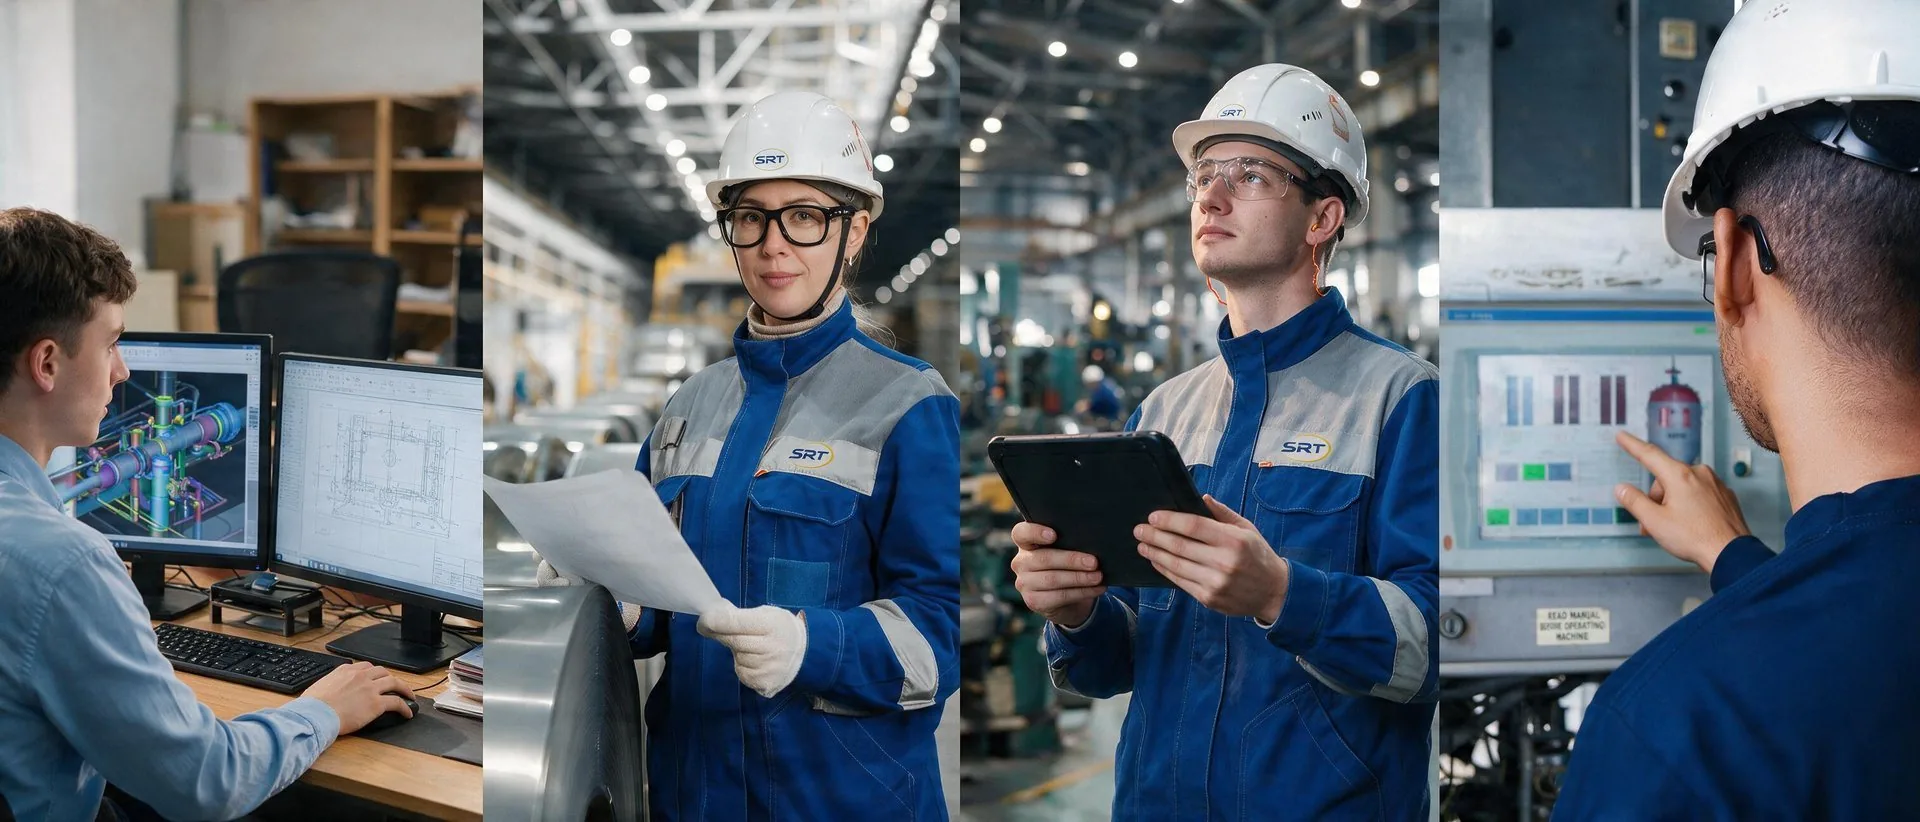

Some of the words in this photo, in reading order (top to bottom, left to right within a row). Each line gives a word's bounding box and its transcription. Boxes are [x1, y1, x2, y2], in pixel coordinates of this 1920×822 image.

[1220, 109, 1243, 117] SRT
[755, 155, 785, 165] SRT
[1281, 441, 1326, 453] SRT
[789, 448, 829, 461] SRT
[1547, 611, 1568, 620] READ
[1570, 611, 1600, 620] MANUAL
[1564, 620, 1606, 631] OPERATING
[1556, 632, 1589, 641] MACHINE
